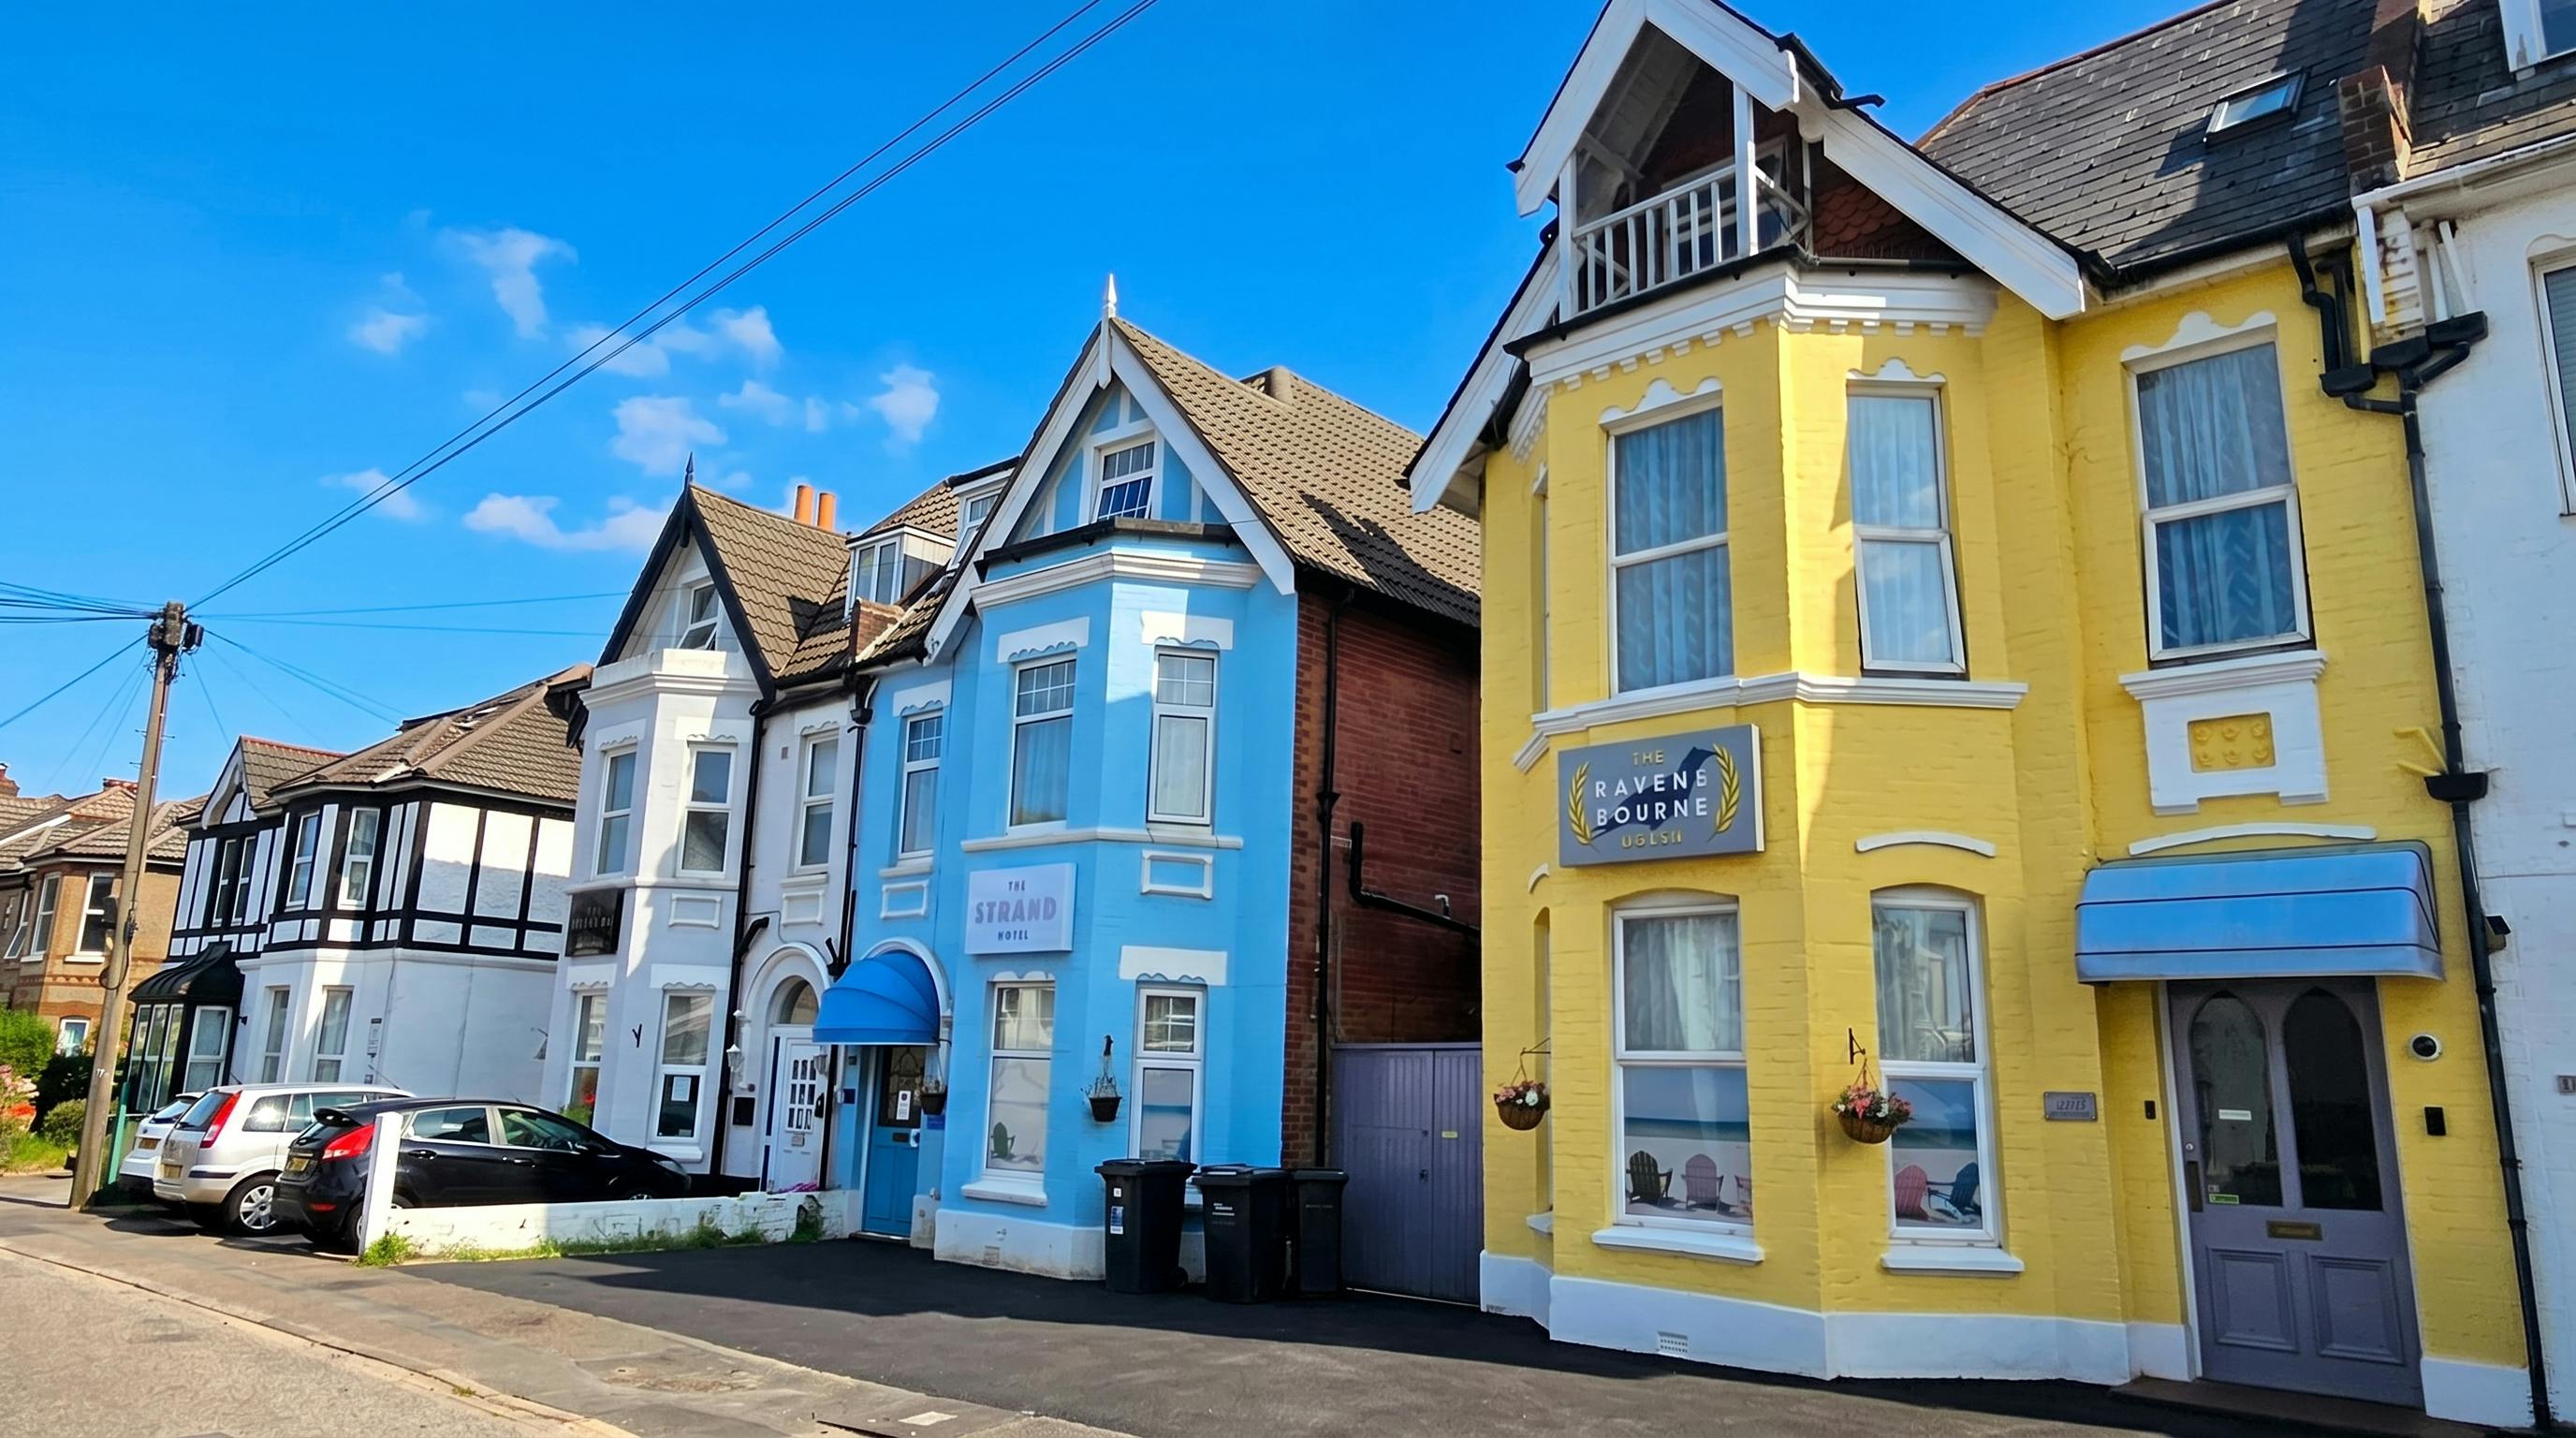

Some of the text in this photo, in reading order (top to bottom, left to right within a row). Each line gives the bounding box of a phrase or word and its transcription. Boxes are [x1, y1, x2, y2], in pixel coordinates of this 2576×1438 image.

[1632, 750, 1664, 766] THE
[1597, 798, 1708, 827] BOURNE
[1008, 880, 1026, 891] THE
[974, 896, 1057, 924] STRAND
[998, 930, 1029, 941] HOTEL
